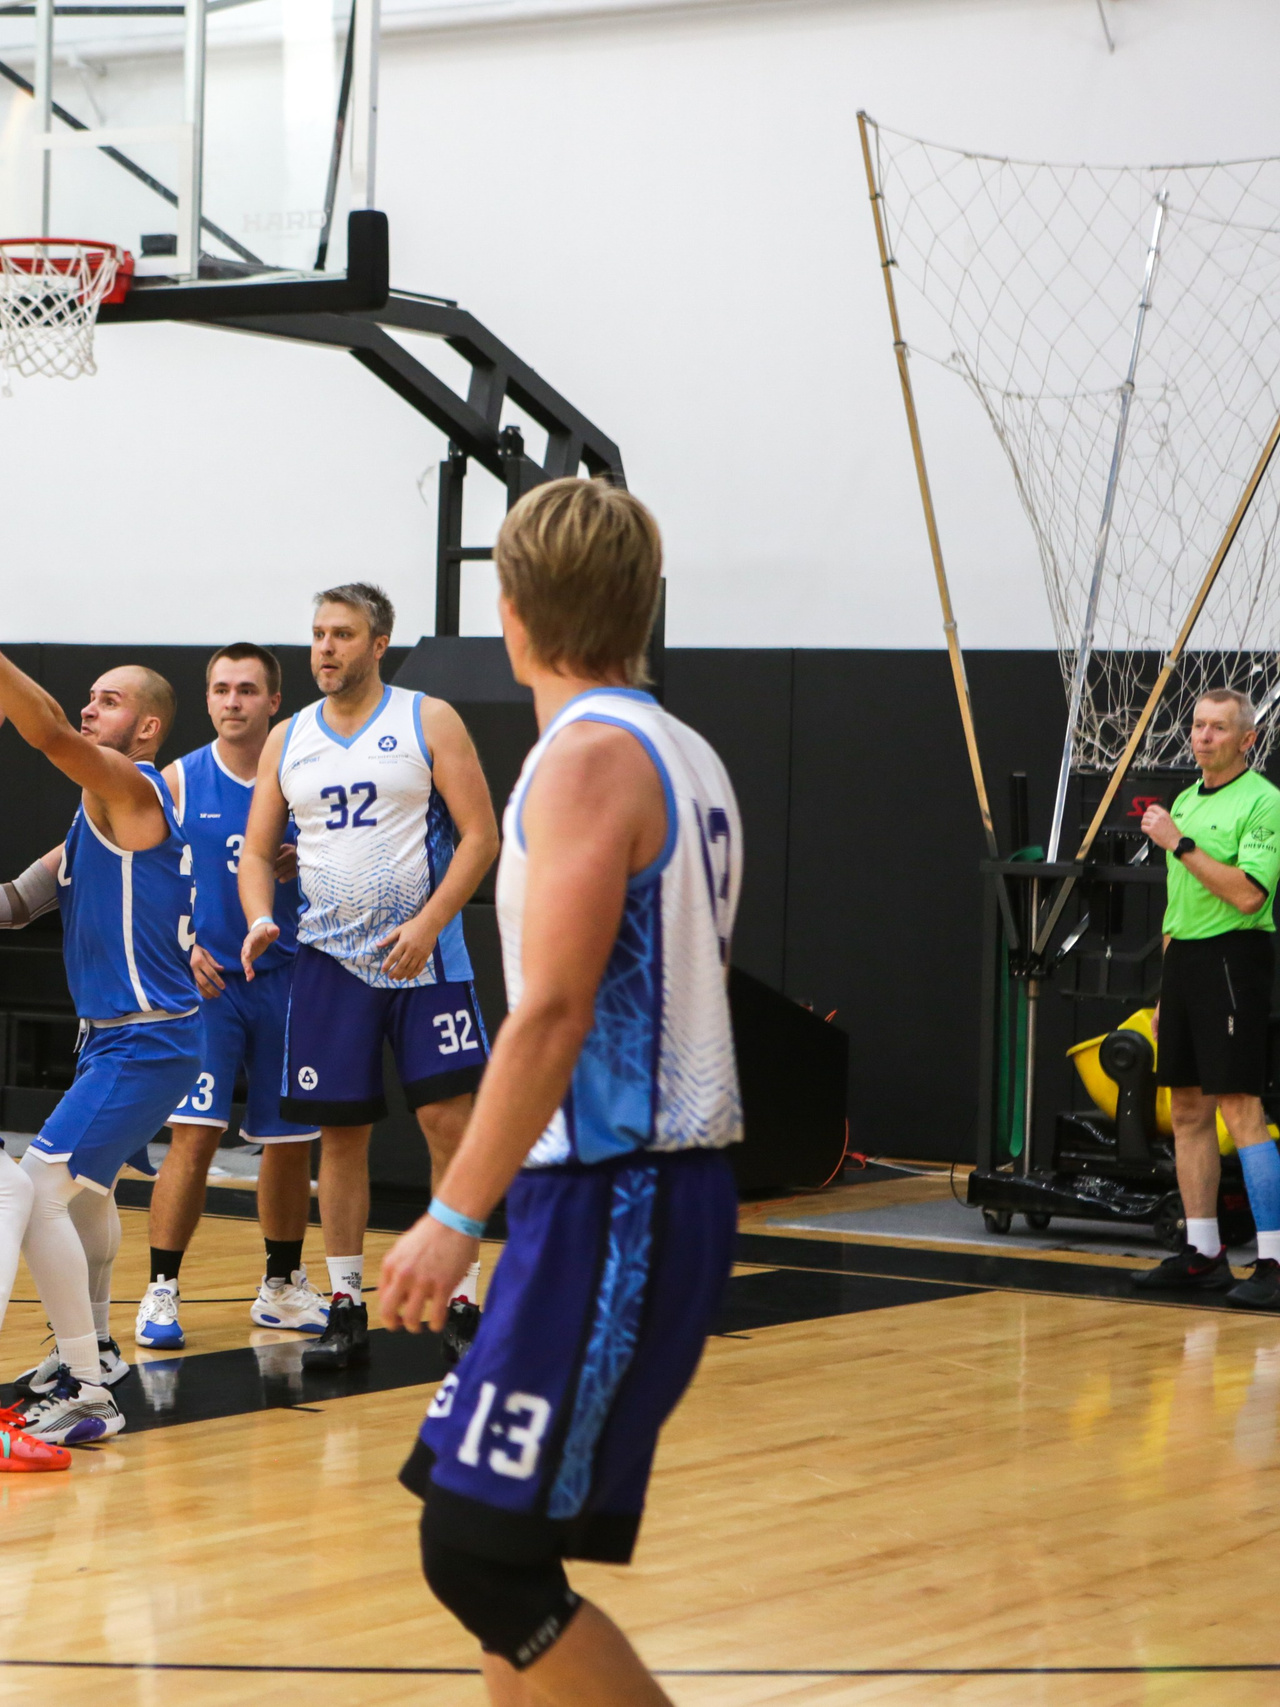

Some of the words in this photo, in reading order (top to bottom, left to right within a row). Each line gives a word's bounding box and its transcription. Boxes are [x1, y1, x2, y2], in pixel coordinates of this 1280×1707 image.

[321, 782, 378, 830] 32
[432, 1009, 478, 1055] 32
[176, 1071, 216, 1112] 3
[457, 1381, 553, 1481] 13
